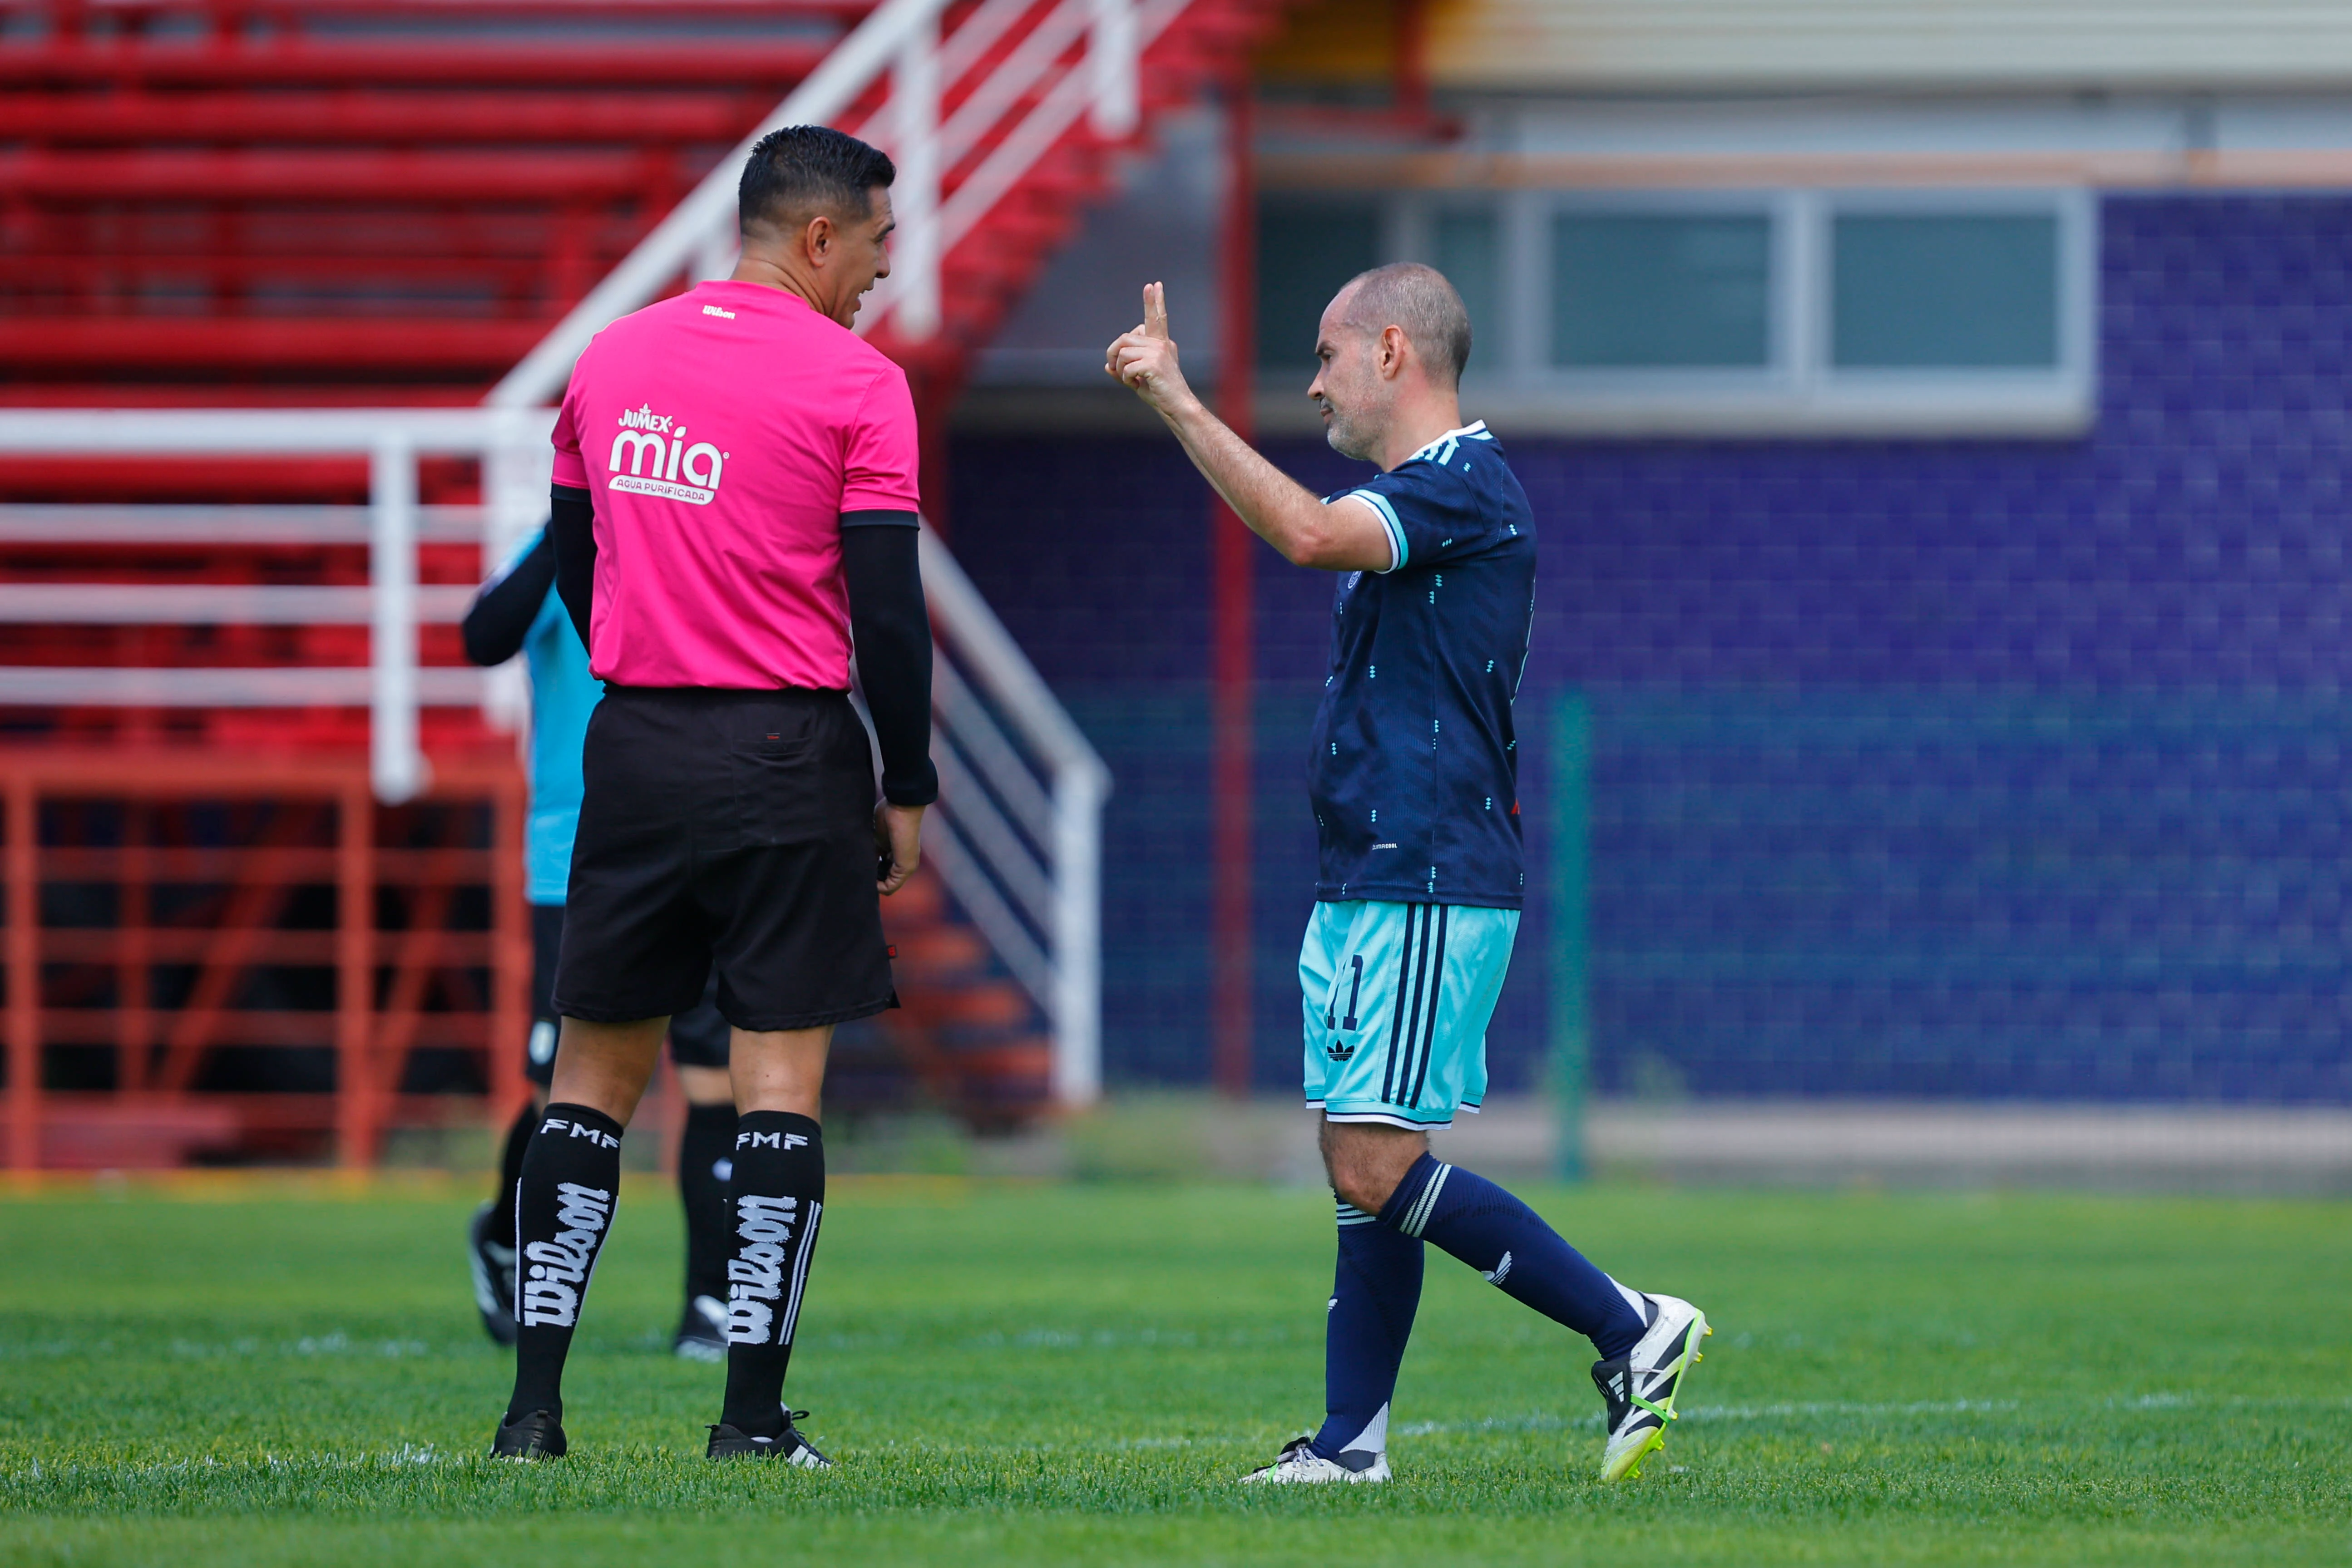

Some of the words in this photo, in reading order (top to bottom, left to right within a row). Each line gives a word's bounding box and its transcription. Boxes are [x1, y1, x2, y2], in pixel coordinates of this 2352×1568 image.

[702, 305, 736, 320] Wilson
[618, 409, 673, 433] JUMEX
[617, 479, 642, 490] AGUA
[644, 483, 705, 501] PURIFICADA
[540, 1118, 619, 1149] FMF
[736, 1131, 808, 1151] FMF
[524, 1182, 610, 1327] Wilson
[727, 1194, 797, 1347] Wilson
